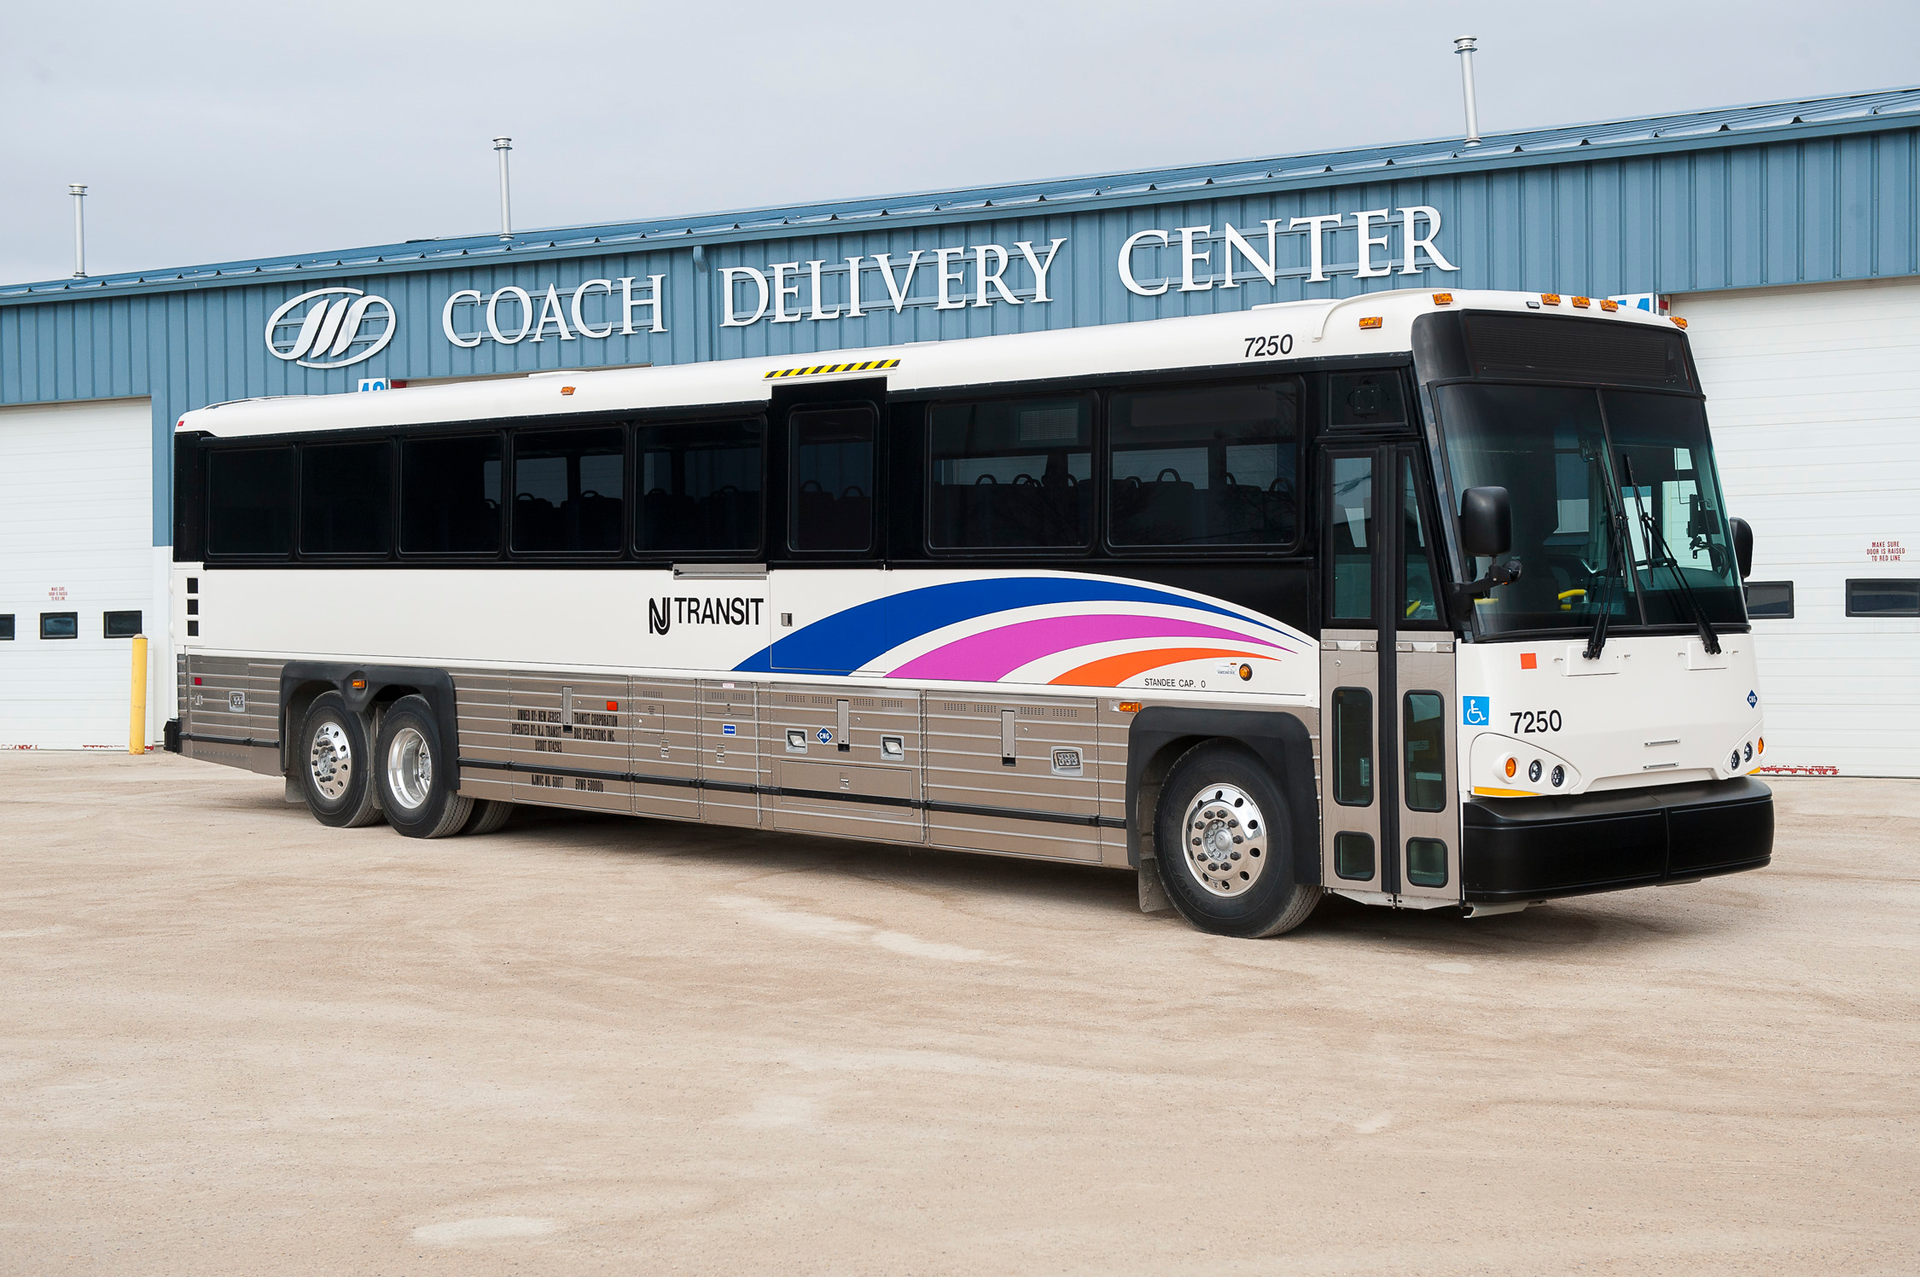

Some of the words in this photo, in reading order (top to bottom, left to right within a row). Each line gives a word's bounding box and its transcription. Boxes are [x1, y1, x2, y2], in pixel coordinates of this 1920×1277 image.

[442, 274, 668, 347] COACH
[718, 237, 1067, 327] DELIVERY
[1118, 205, 1460, 296] CENTER
[1244, 333, 1293, 358] 7250
[674, 597, 764, 625] TRANSIT
[1144, 678, 1176, 687] STANDEE
[1178, 679, 1196, 688] CAP.
[517, 709, 530, 721] OWNED
[538, 710, 546, 722] NEW
[548, 711, 561, 723] JERSEY
[574, 712, 590, 725] TRANSIT
[591, 713, 617, 727] CORPORATION
[1510, 709, 1562, 734] 7250
[511, 723, 529, 735] OPERATED
[545, 725, 561, 738] TRANSIT
[583, 728, 606, 742] OPERATIONS
[819, 732, 830, 740] CNG
